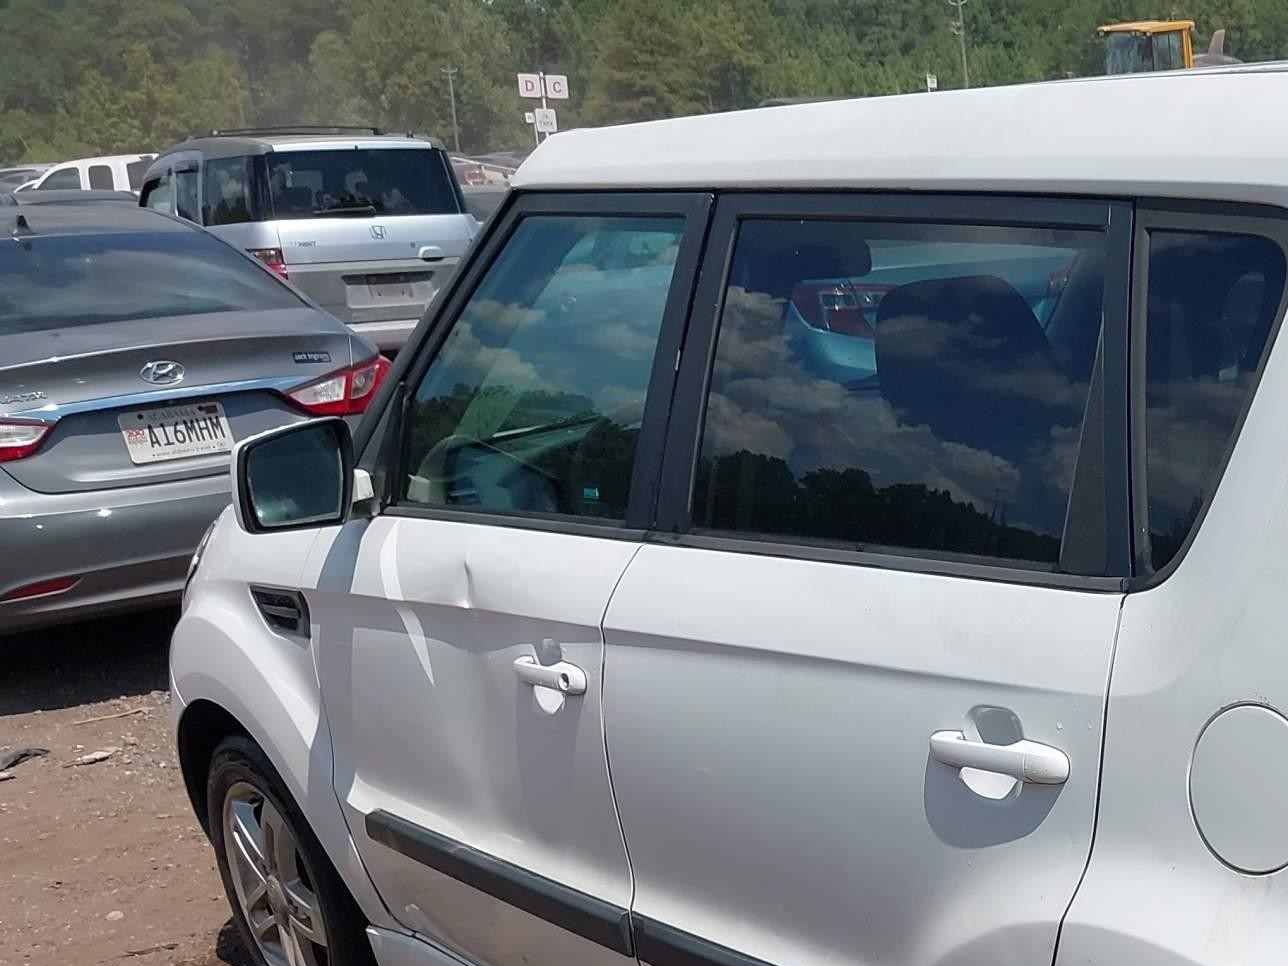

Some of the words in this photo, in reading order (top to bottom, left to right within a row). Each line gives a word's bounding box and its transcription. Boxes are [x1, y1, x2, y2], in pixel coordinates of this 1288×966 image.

[525, 80, 535, 91] D
[553, 81, 562, 93] C
[147, 415, 226, 448] A16MHM
